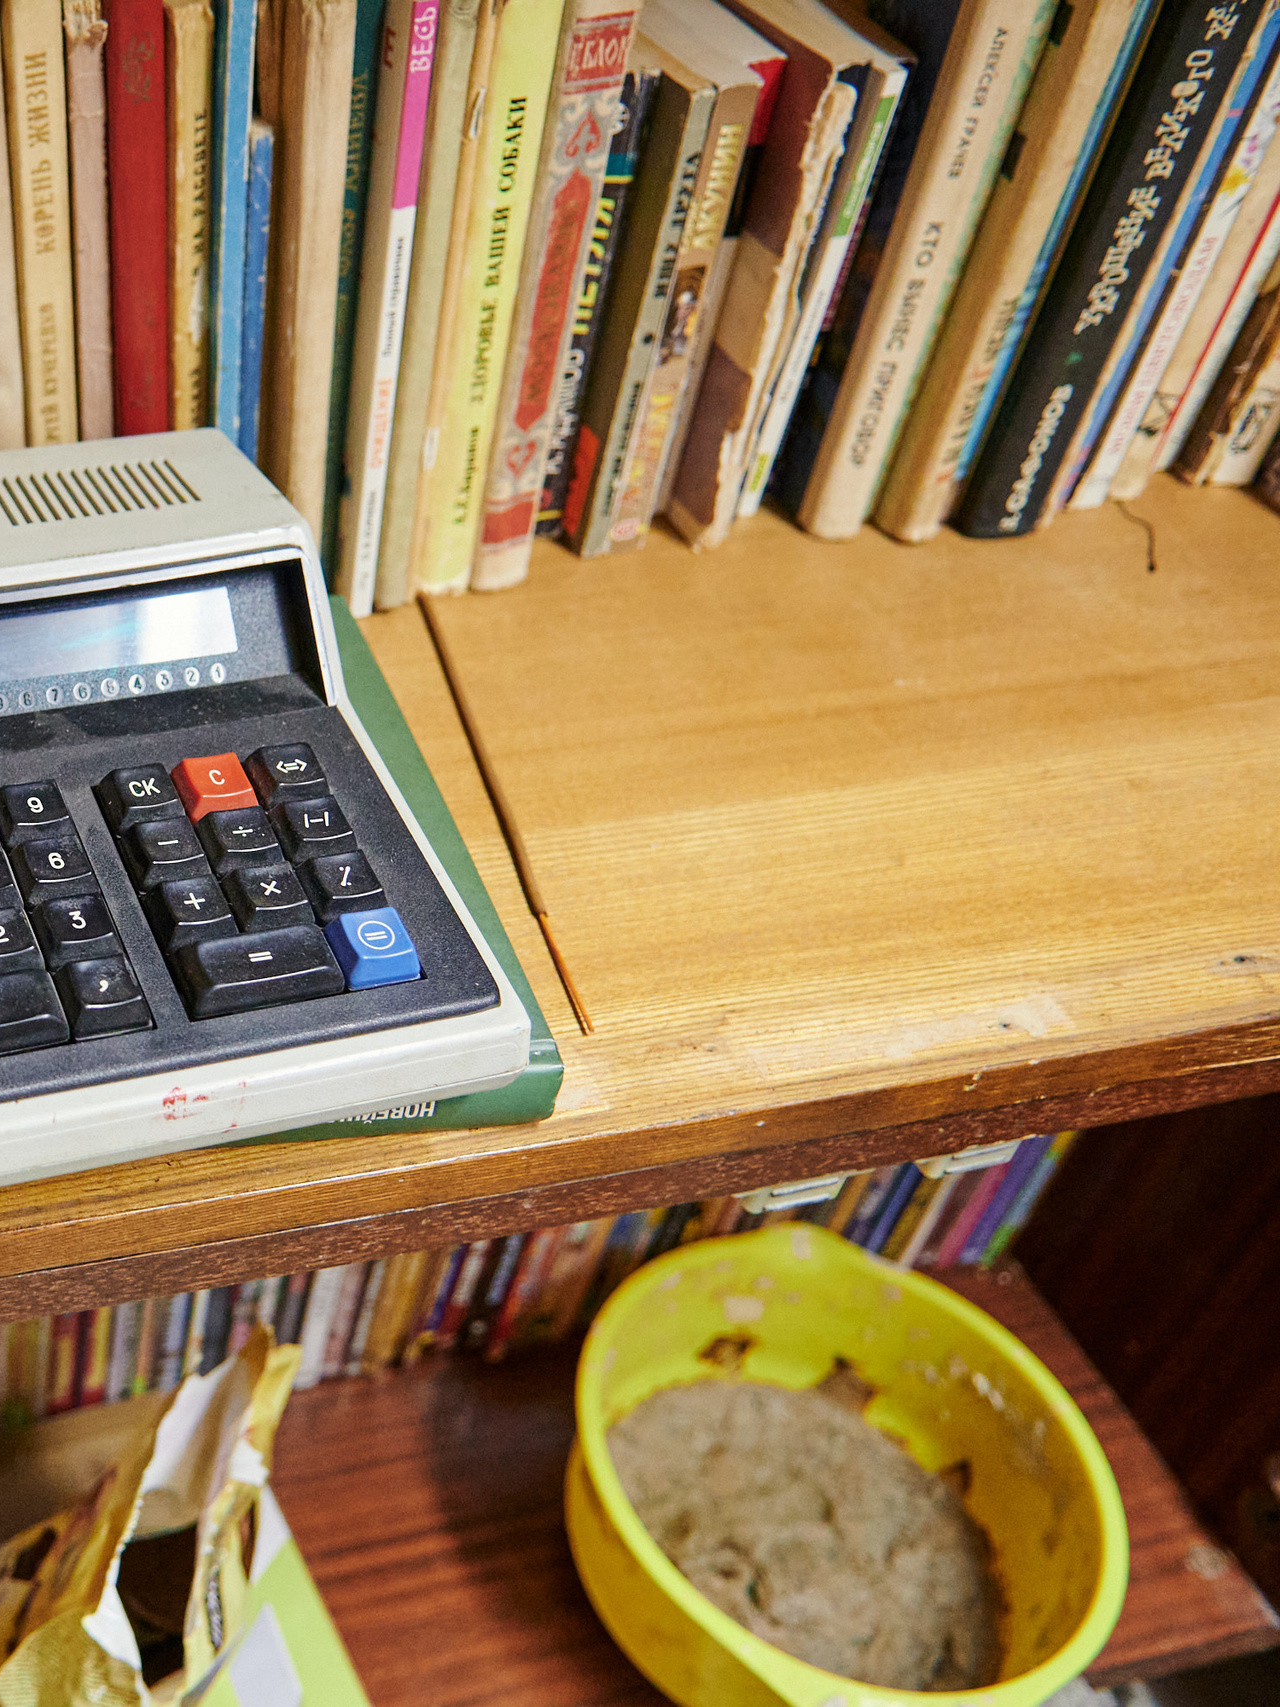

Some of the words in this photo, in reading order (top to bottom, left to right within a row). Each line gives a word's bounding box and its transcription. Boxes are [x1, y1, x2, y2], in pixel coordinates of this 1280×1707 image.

[410, 6, 437, 73] ВЕСЬ
[969, 26, 1009, 110] АЛЕКСЕЙ
[23, 50, 50, 149] ЖИЗНИ
[497, 95, 529, 194] СОБАКИ
[30, 157, 56, 256] КОРЕНЬ
[670, 150, 702, 230] ДРУГА
[690, 123, 744, 250] АКУНИН
[1073, 186, 1161, 336] УКРОЩЕНИЕ
[1144, 48, 1216, 182] ВЕЛИКОГО
[485, 206, 512, 292] ВАШЕЙ
[915, 220, 947, 268] КТО
[885, 279, 926, 354] ВЫНЕС
[849, 361, 897, 470] ПРИГОВОР
[27, 796, 45, 814] 9
[208, 769, 226, 787] С
[48, 851, 66, 870] 6
[68, 910, 88, 930] 3
